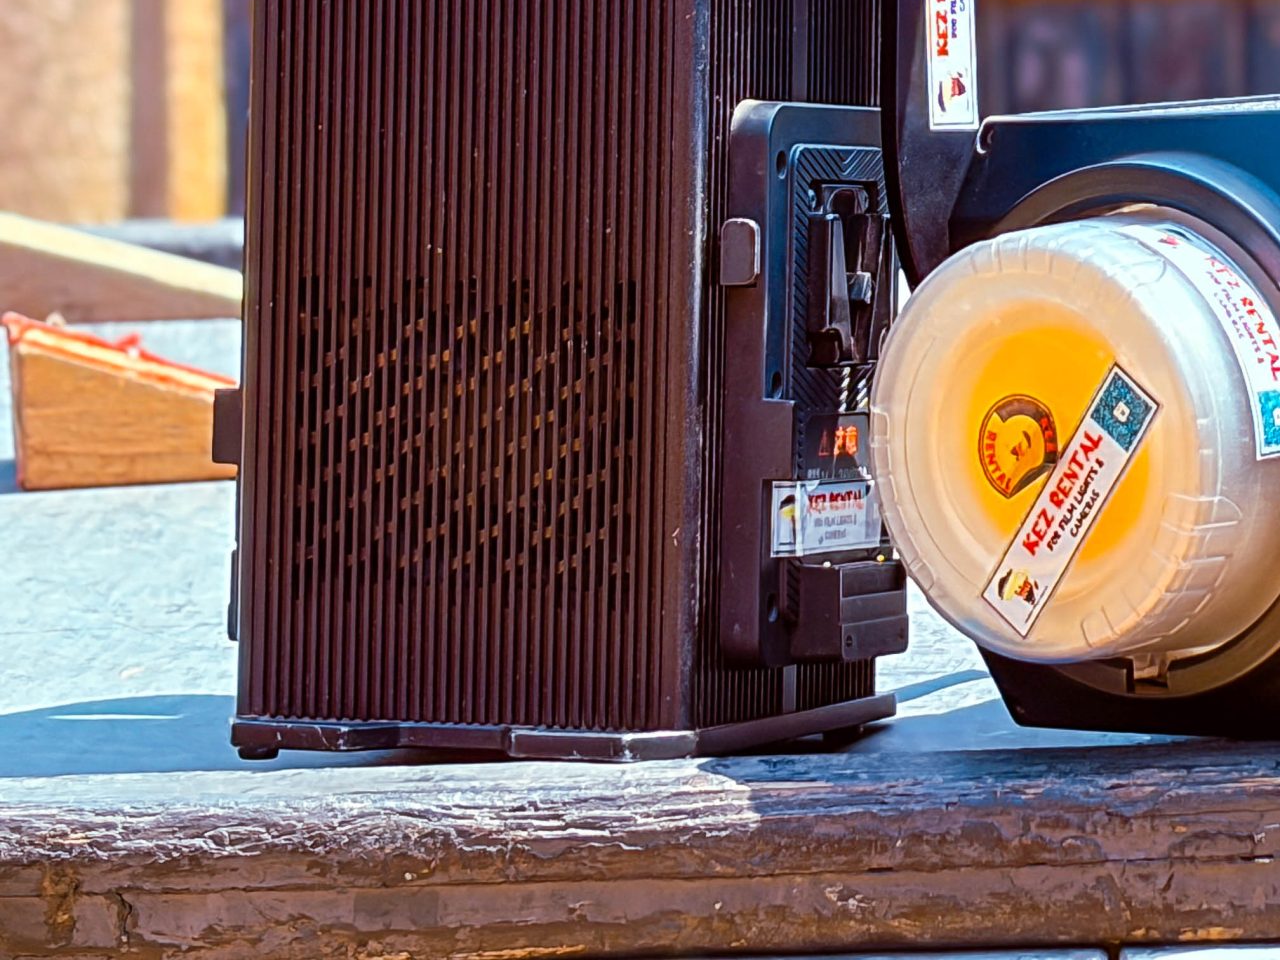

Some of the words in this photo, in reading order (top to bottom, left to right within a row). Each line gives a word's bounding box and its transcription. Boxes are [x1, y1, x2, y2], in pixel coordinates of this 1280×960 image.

[936, 10, 949, 57] KEZ
[1022, 508, 1055, 556] KEZ
[1049, 430, 1104, 509] RENTAL
[1070, 488, 1100, 537] CAMERAS
